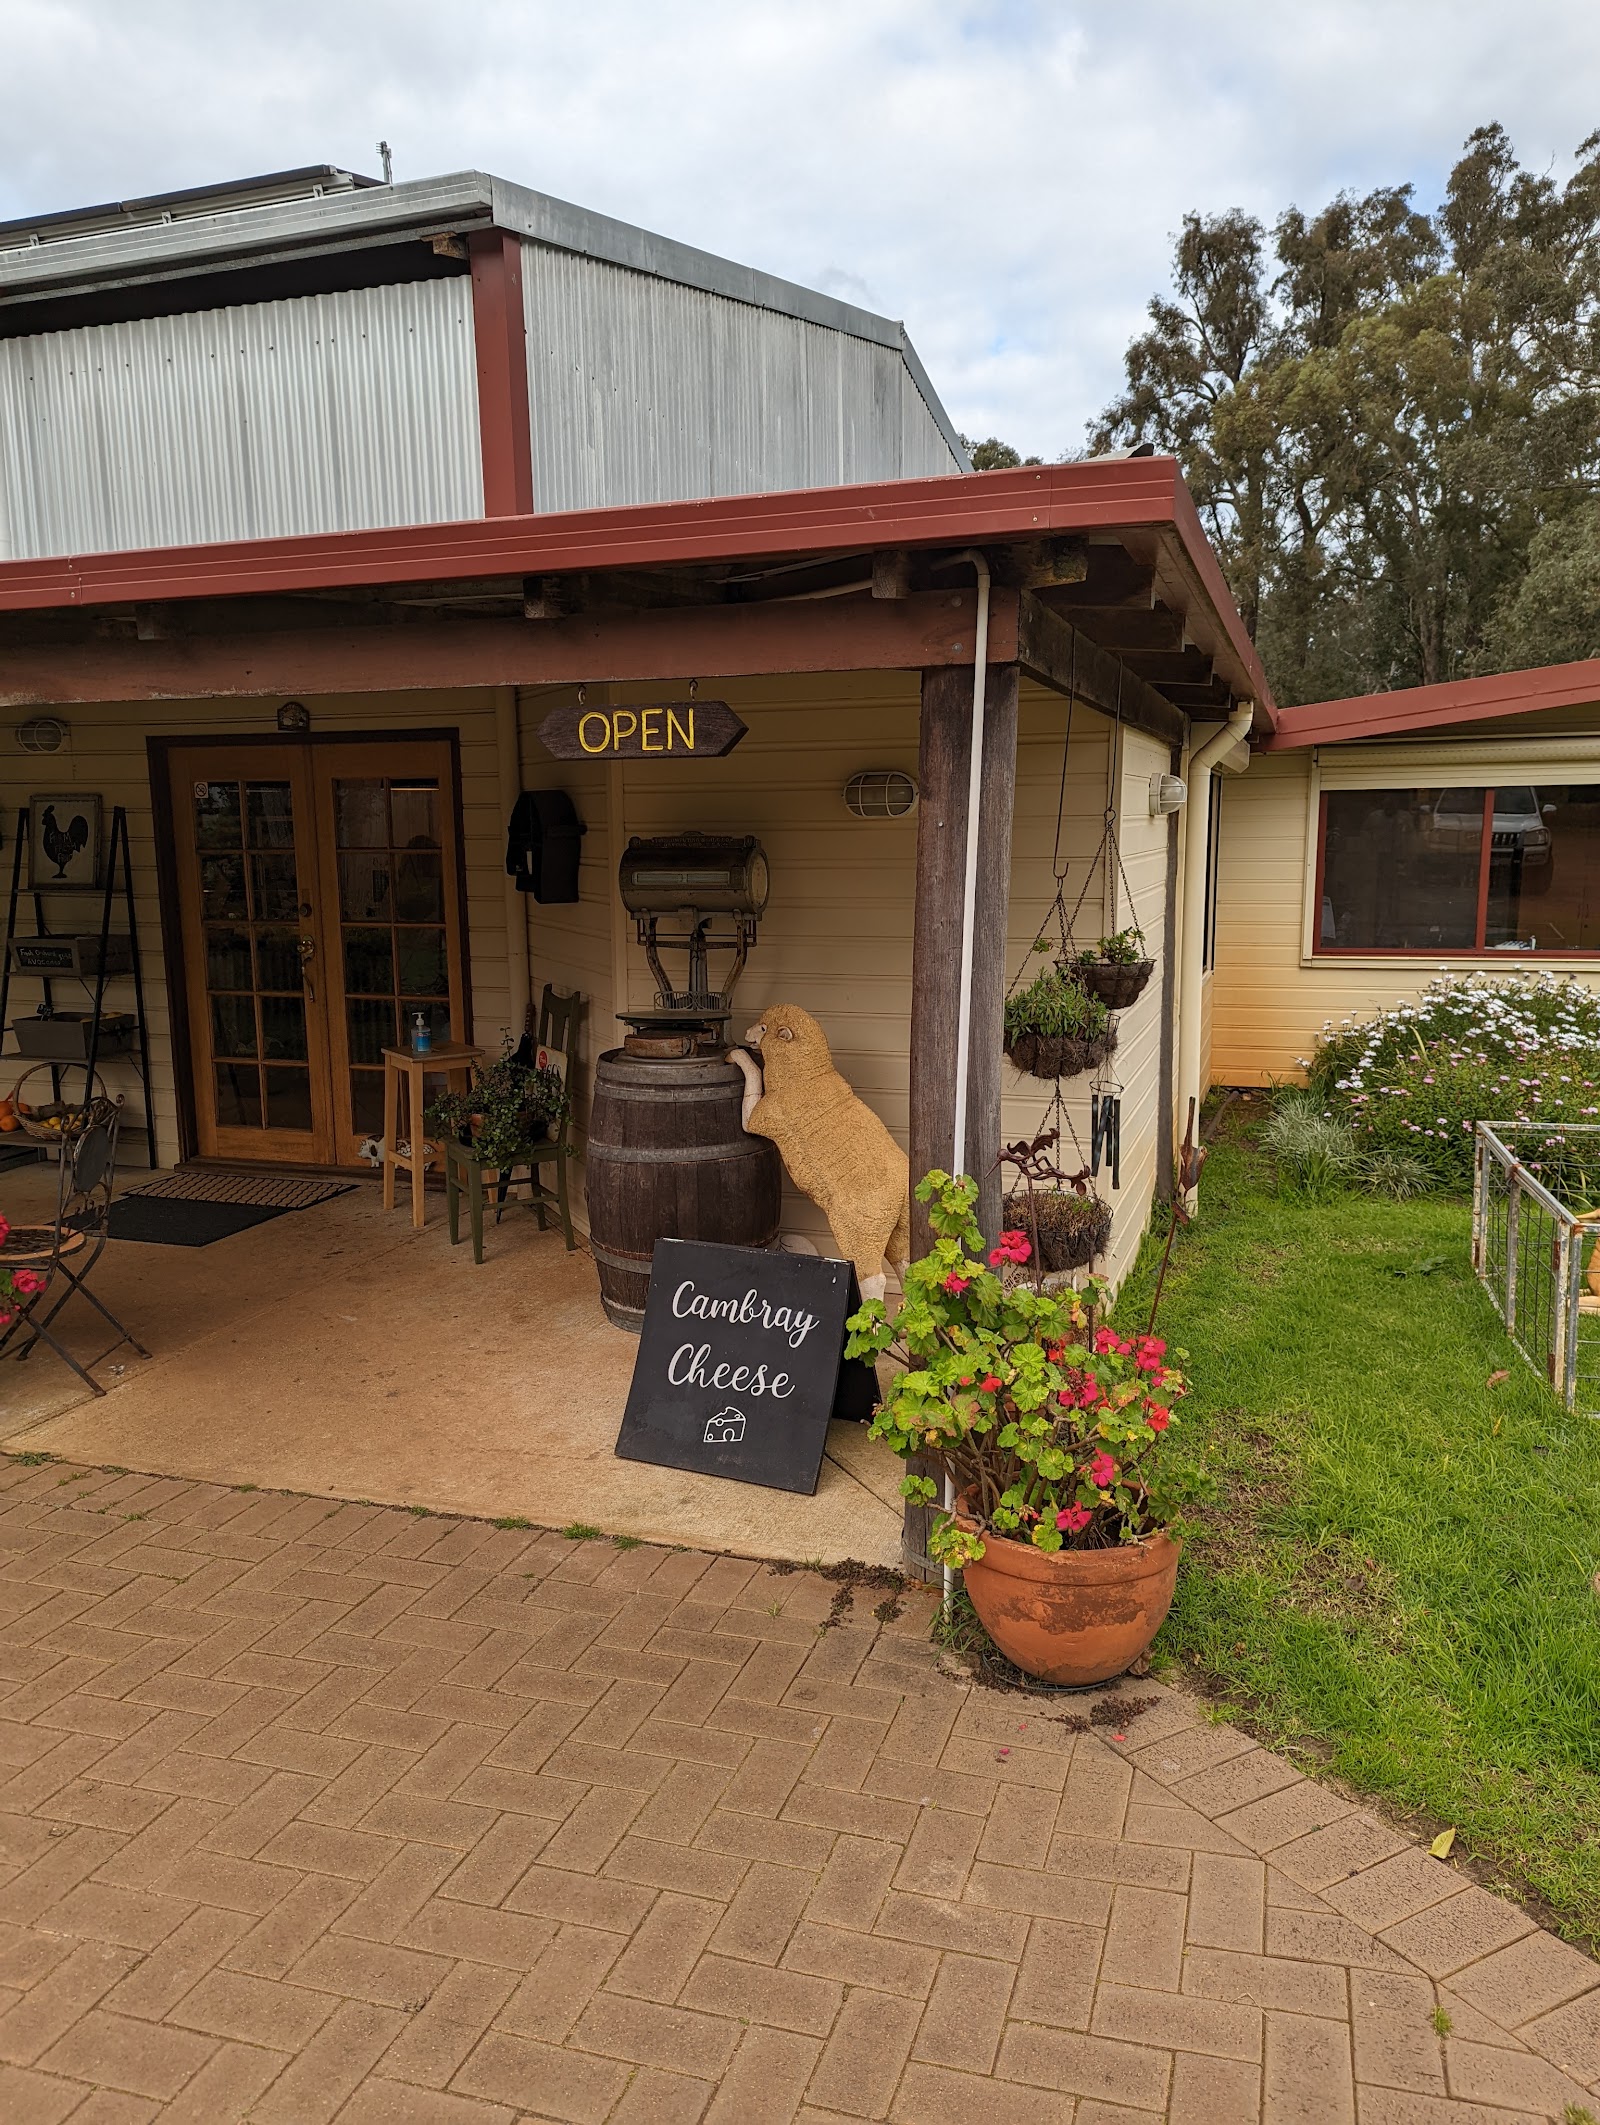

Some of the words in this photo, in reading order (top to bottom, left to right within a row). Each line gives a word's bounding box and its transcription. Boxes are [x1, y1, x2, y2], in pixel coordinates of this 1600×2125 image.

[578, 708, 695, 753] OPEN
[671, 1280, 820, 1349] Cambray
[667, 1343, 796, 1399] Cheese
